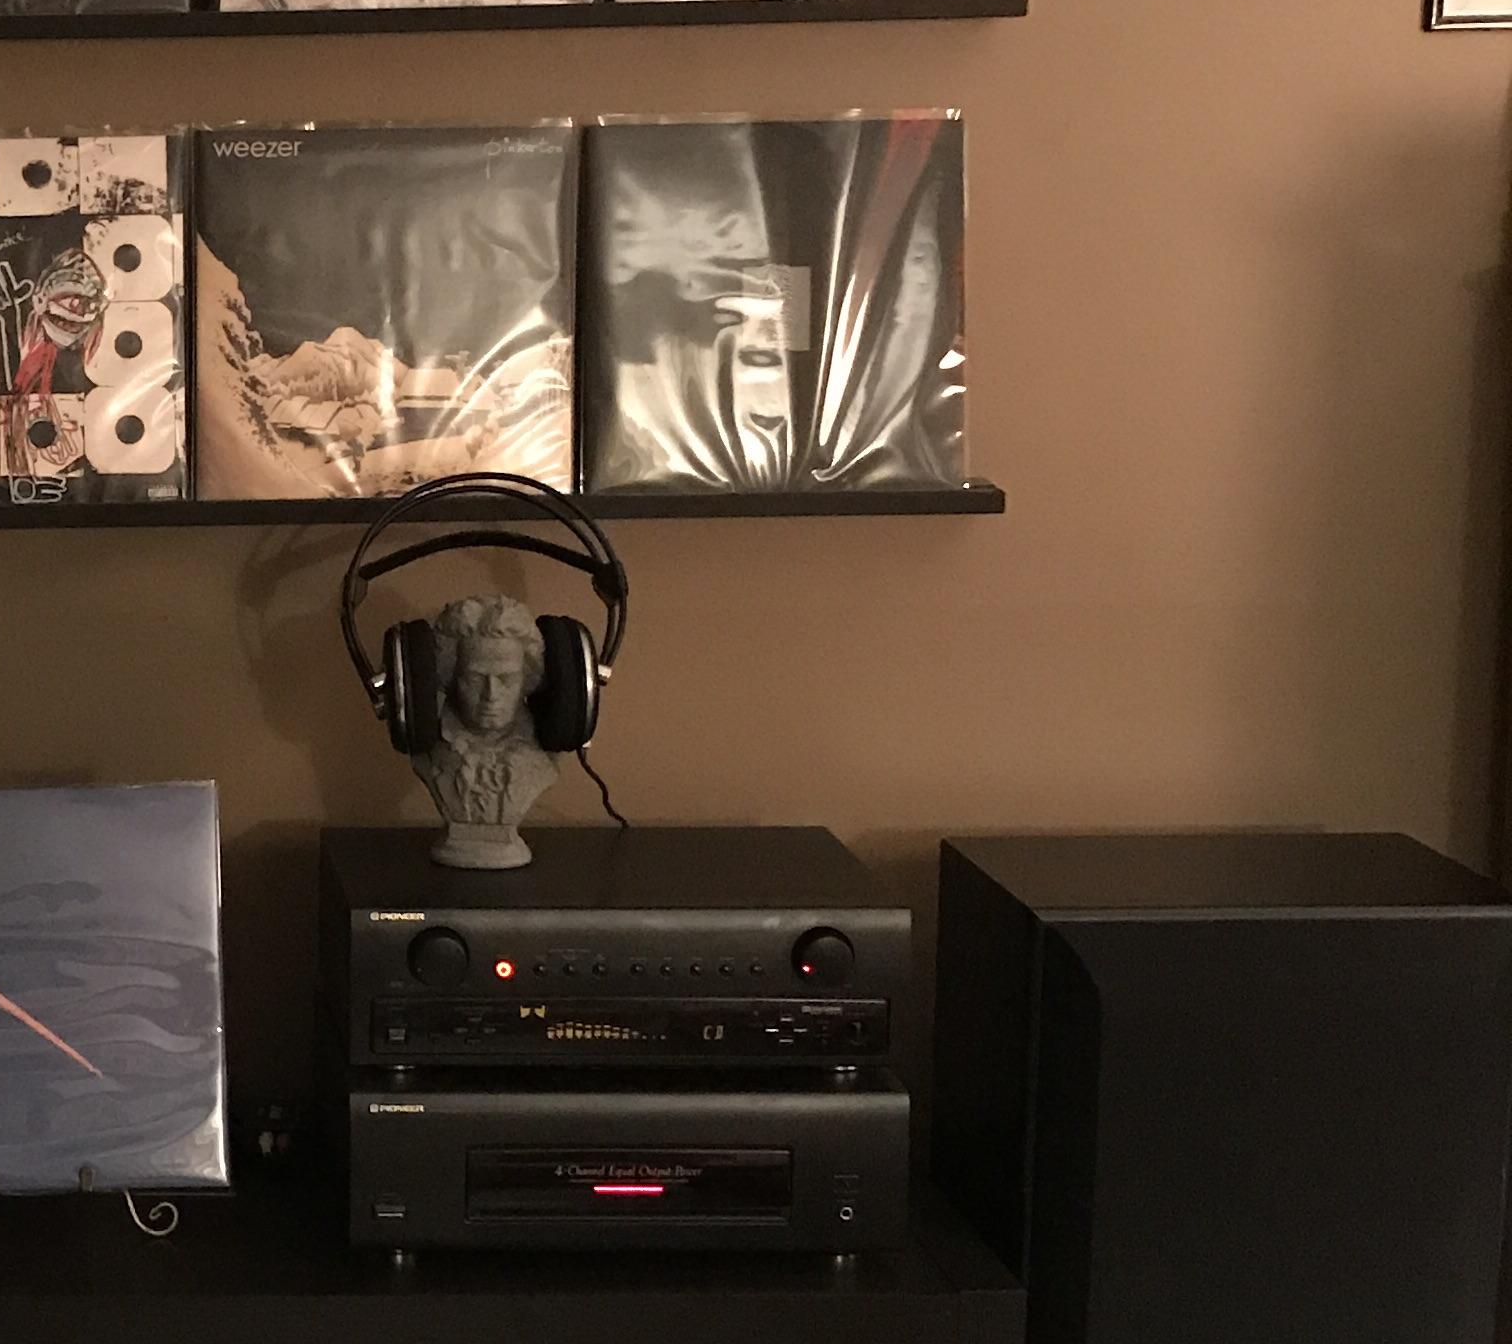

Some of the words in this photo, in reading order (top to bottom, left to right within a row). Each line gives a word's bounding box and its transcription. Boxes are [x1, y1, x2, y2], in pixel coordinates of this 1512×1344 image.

[212, 139, 303, 158] weezer
[380, 911, 426, 921] PIONEER
[379, 1104, 425, 1113] PIONEER
